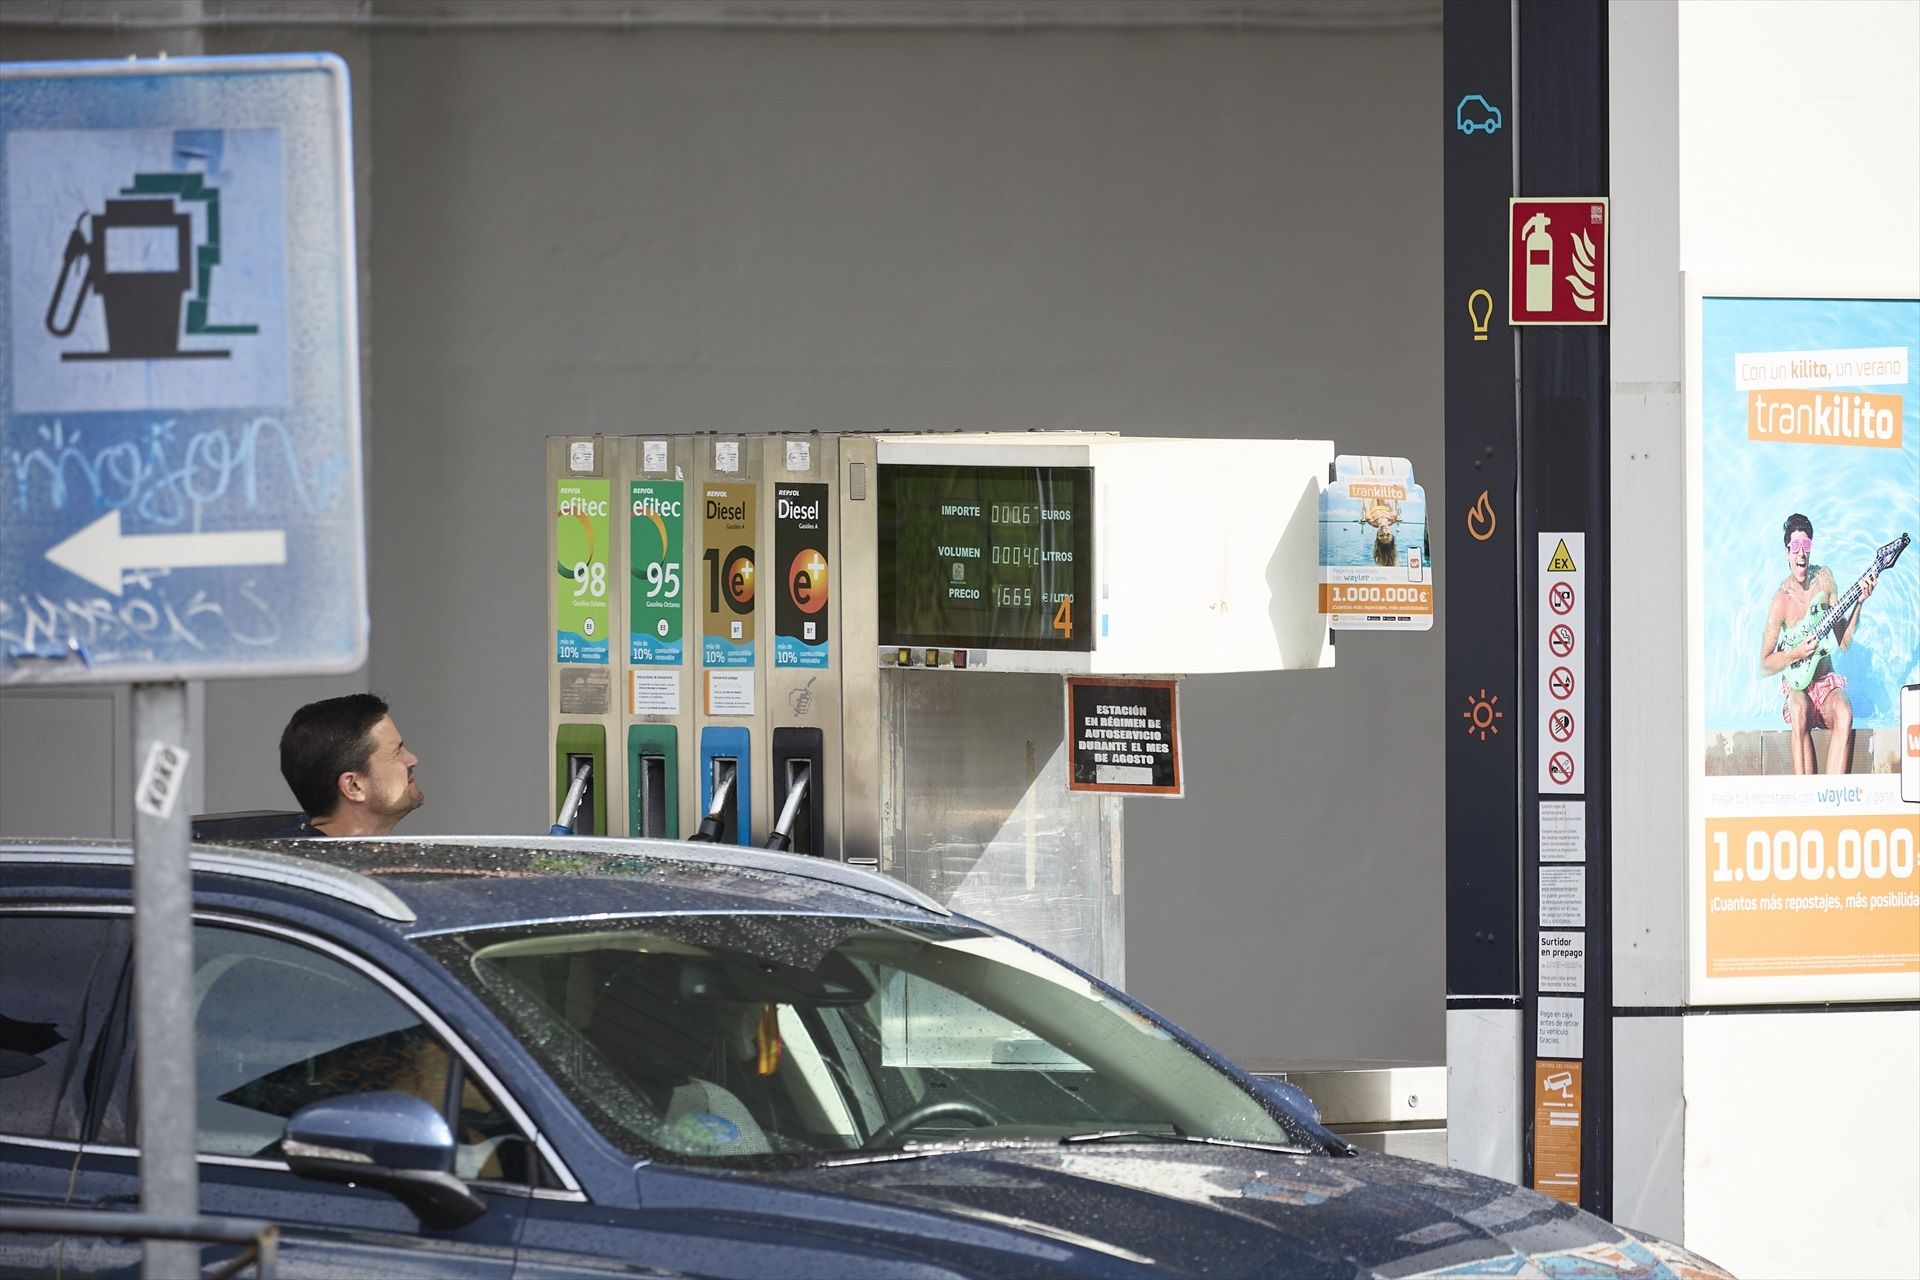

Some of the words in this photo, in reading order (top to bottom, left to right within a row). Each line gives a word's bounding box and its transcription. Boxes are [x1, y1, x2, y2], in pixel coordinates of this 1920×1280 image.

[1742, 363, 1766, 381] Con
[1770, 364, 1787, 380] un
[1791, 360, 1832, 381] kilito,
[1836, 362, 1851, 377] un
[1857, 360, 1901, 377] verano
[1755, 394, 1894, 440] trankilito
[560, 487, 582, 495] REPSOL
[633, 487, 655, 495] REPSOL
[706, 490, 728, 498] REPSOL
[1351, 485, 1404, 498] trankilito
[560, 497, 608, 518] efitec
[633, 498, 682, 518] efitec
[706, 500, 746, 521] Diesel
[778, 499, 819, 520] Diesel
[941, 505, 981, 517] IMPORTE
[1041, 509, 1071, 521] EUROS
[938, 546, 981, 558] VOLUMEN
[1041, 551, 1073, 562] LITROS
[1554, 558, 1569, 570] EX
[574, 562, 606, 597] 98
[646, 562, 680, 598] 95
[1344, 574, 1370, 582] waylet
[948, 588, 980, 600] PRECIO
[1053, 599, 1073, 639] 4
[560, 646, 580, 659] 10%
[633, 648, 653, 660] 10%
[706, 651, 725, 663] 10%
[778, 651, 798, 663] 10%
[1096, 705, 1147, 716] ESTACIÓN
[1085, 717, 1099, 726] EN
[1100, 716, 1146, 728] RÉGIMEN
[1148, 719, 1162, 729] DE
[1085, 729, 1162, 741] AUTOSERVICIO
[1078, 741, 1128, 752] DURANTE
[1131, 743, 1142, 752] EL
[1146, 743, 1169, 753] MES
[1094, 753, 1109, 763] DE
[1112, 754, 1155, 765] AGOSTO
[1817, 786, 1862, 807] waylet
[1713, 828, 1920, 882] 1.000.000
[1711, 896, 1758, 913] ¡Cuantos
[1760, 893, 1782, 911] más
[1785, 893, 1843, 913] repostajes,
[1846, 892, 1868, 908] más
[1541, 937, 1572, 946] Surtidor
[1552, 949, 1583, 959] prepago
[1540, 1010, 1554, 1019] Paga
[1562, 1011, 1573, 1019] caja
